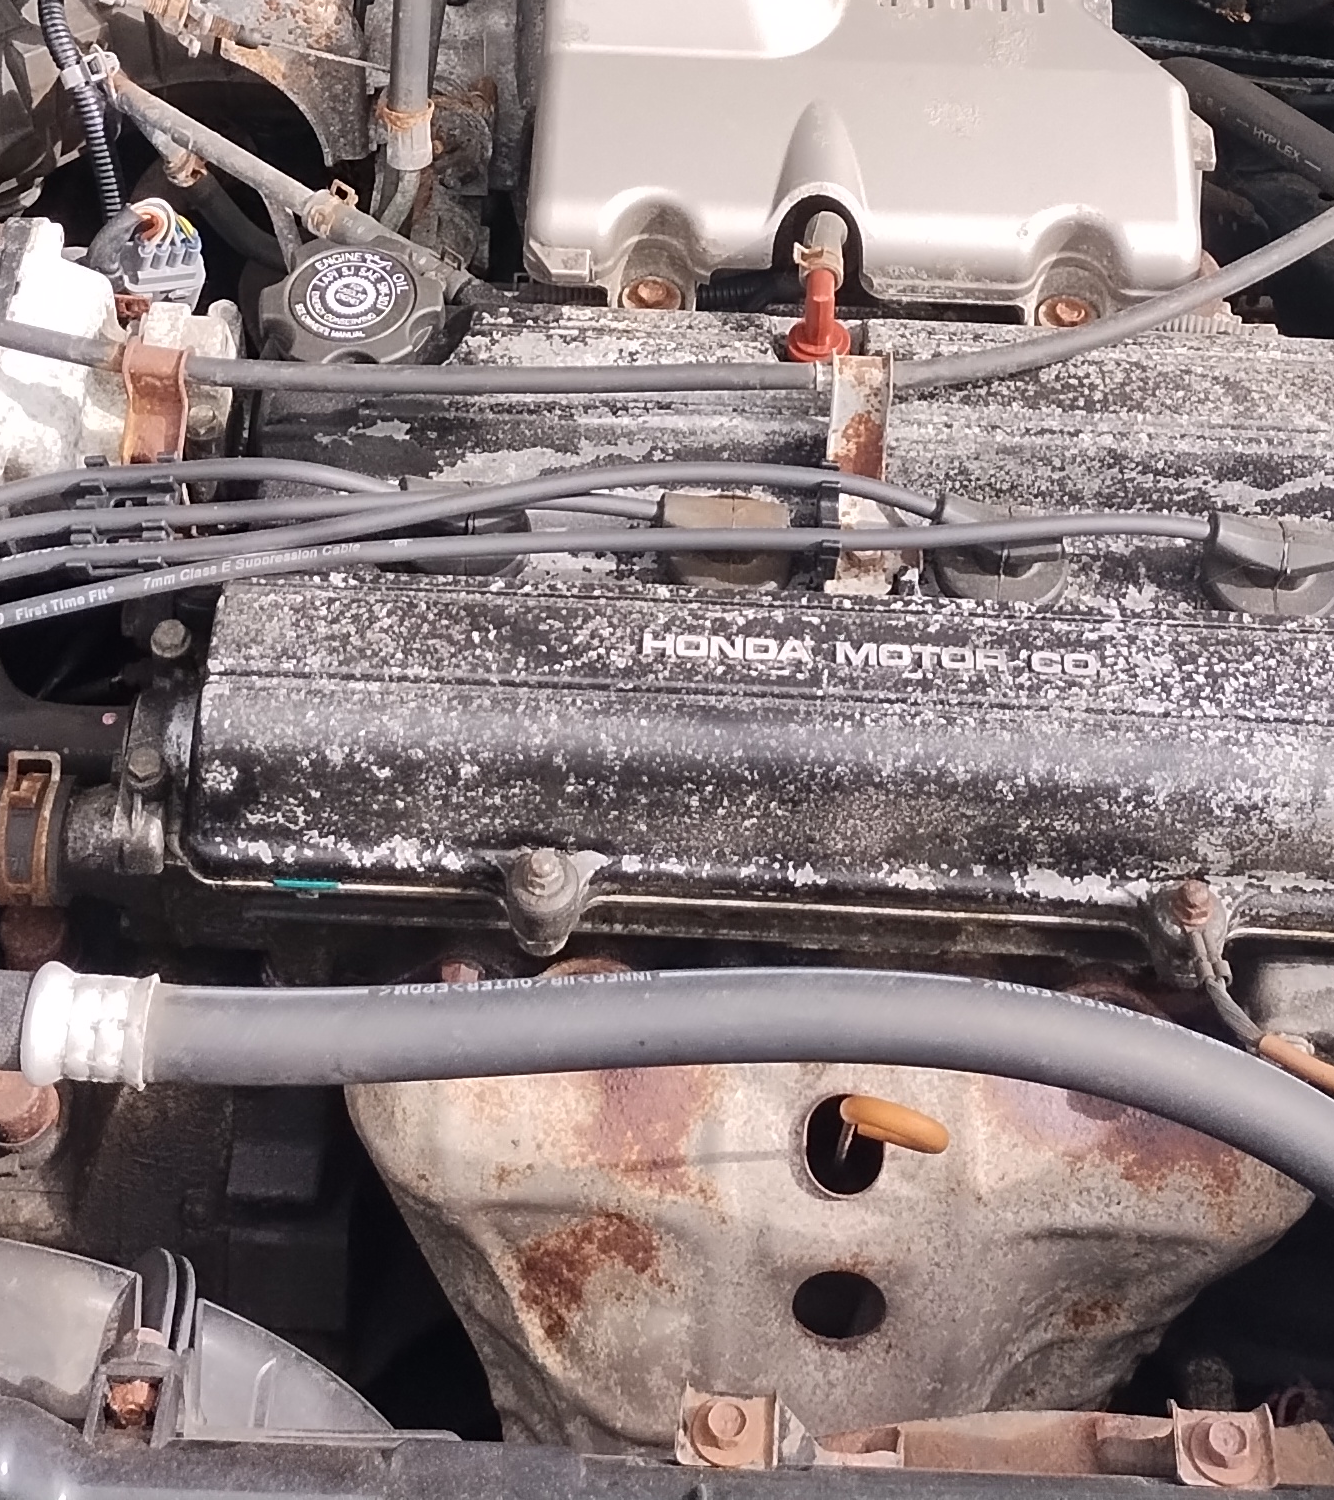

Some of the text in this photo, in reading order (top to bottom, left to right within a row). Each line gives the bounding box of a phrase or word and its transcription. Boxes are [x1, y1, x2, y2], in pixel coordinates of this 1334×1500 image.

[1253, 126, 1301, 162] HYPLEX
[315, 252, 410, 295] ENGINE OIL
[358, 267, 382, 282] SAE
[330, 329, 366, 338] MANUAL
[15, 603, 47, 621] First
[50, 595, 85, 611] Time
[143, 574, 176, 590] 7mm
[180, 565, 217, 581] Class
[222, 560, 232, 572] E
[235, 548, 318, 570] Suppression
[322, 542, 361, 556] Cable
[643, 632, 812, 663] HONDA
[836, 642, 1007, 672] MOTOR
